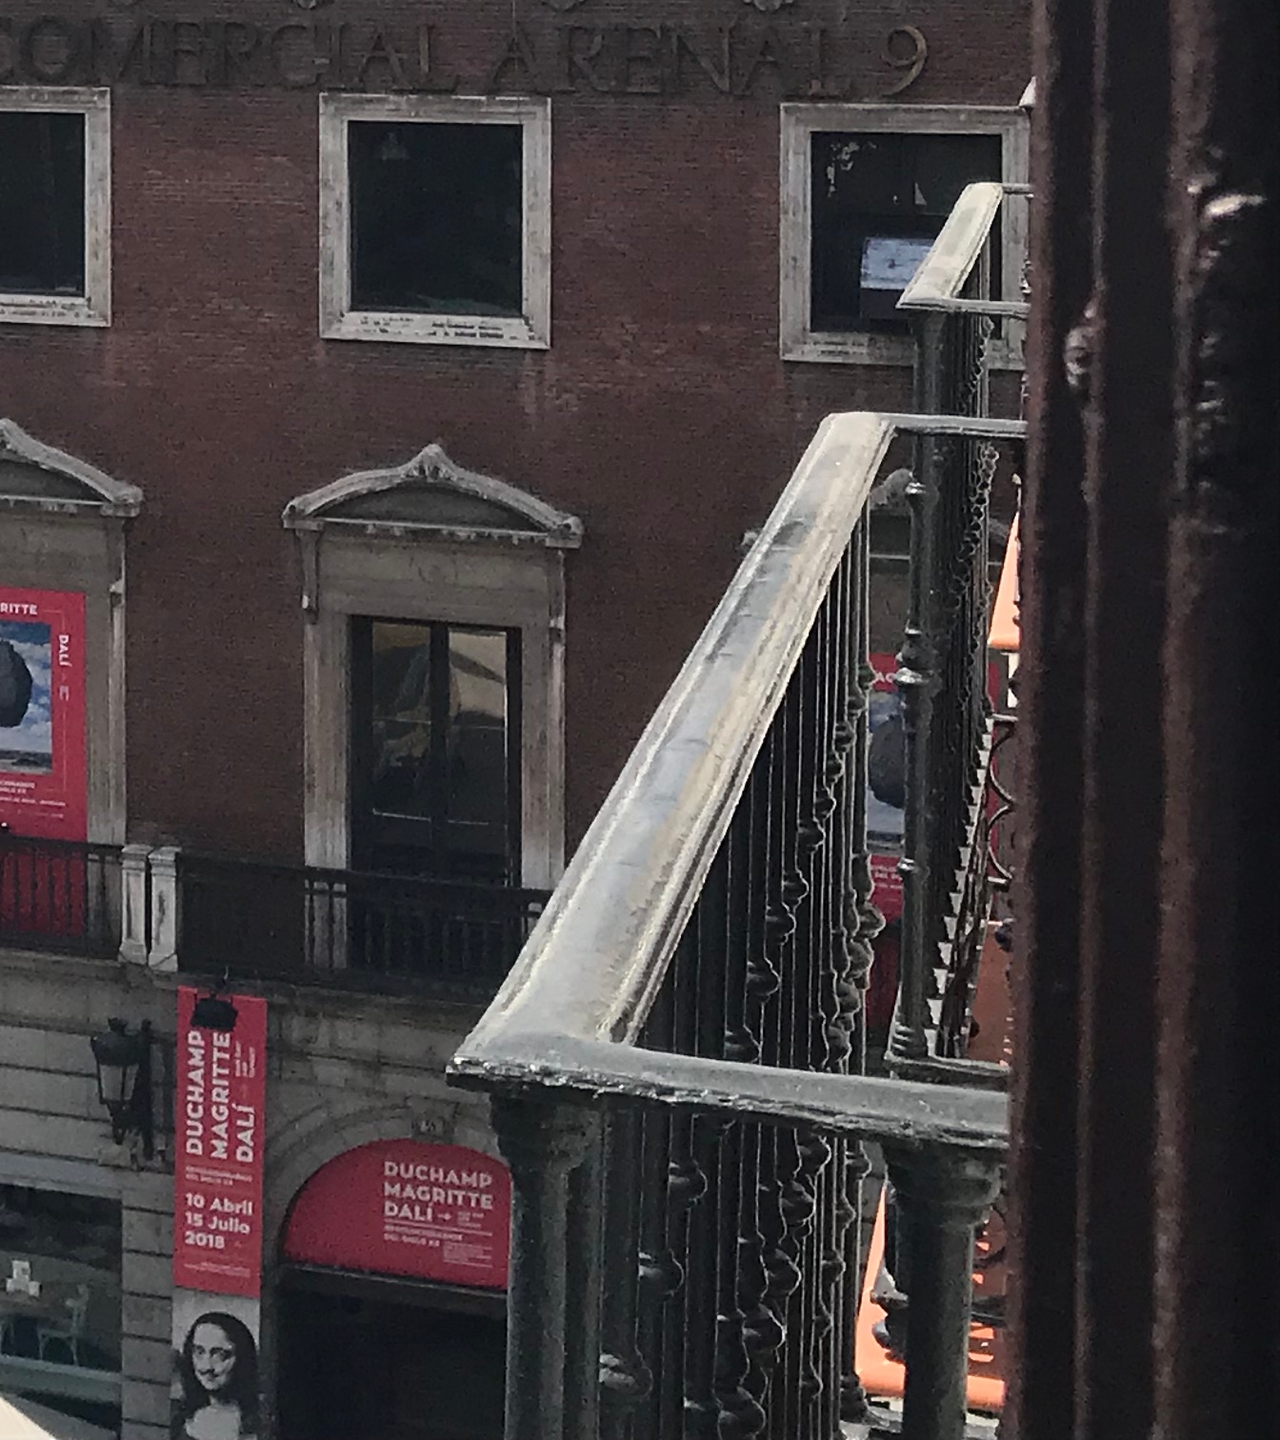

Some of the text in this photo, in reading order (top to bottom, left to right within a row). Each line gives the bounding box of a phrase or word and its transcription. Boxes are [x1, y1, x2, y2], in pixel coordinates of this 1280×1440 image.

[490, 19, 850, 97] ARENAL
[880, 24, 930, 97] 9
[58, 634, 73, 668] DALÍ
[186, 1030, 205, 1155] DUCHAMP
[210, 1032, 230, 1160] MAGRITTE
[231, 1102, 255, 1163] DALÍ
[384, 1161, 493, 1189] DUCHAMP
[185, 1192, 253, 1217] 10 Abril
[384, 1181, 493, 1210] MAGRITTE
[185, 1211, 251, 1235] 15 Julio
[384, 1200, 433, 1221] DALÍ
[185, 1230, 225, 1250] 2018
